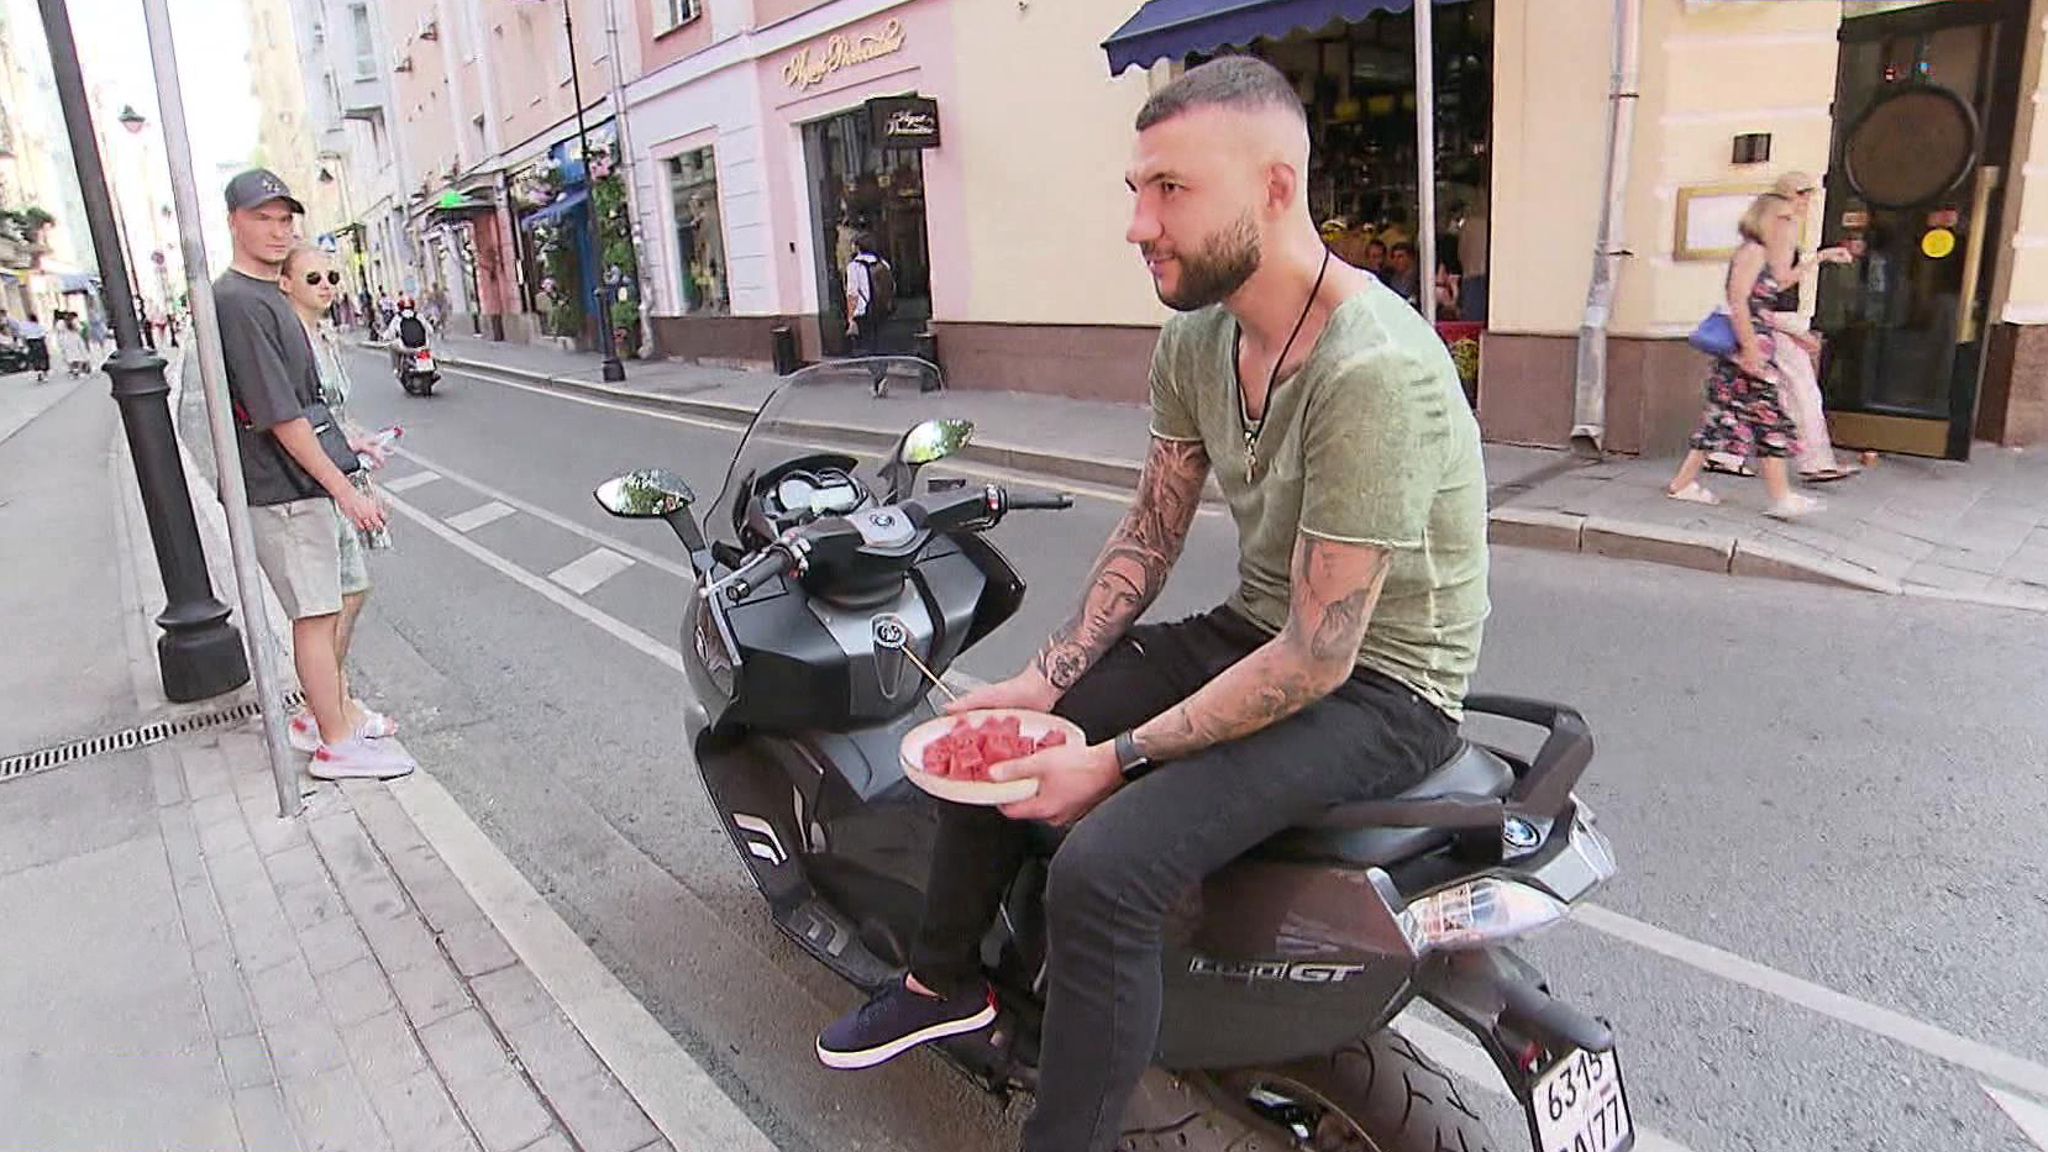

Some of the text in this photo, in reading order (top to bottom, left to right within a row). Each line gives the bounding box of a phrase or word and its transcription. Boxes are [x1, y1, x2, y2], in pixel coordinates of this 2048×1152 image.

[1289, 963, 1364, 982] GT
[1549, 1052, 1603, 1121] 6315
[1593, 1094, 1619, 1150] 77
